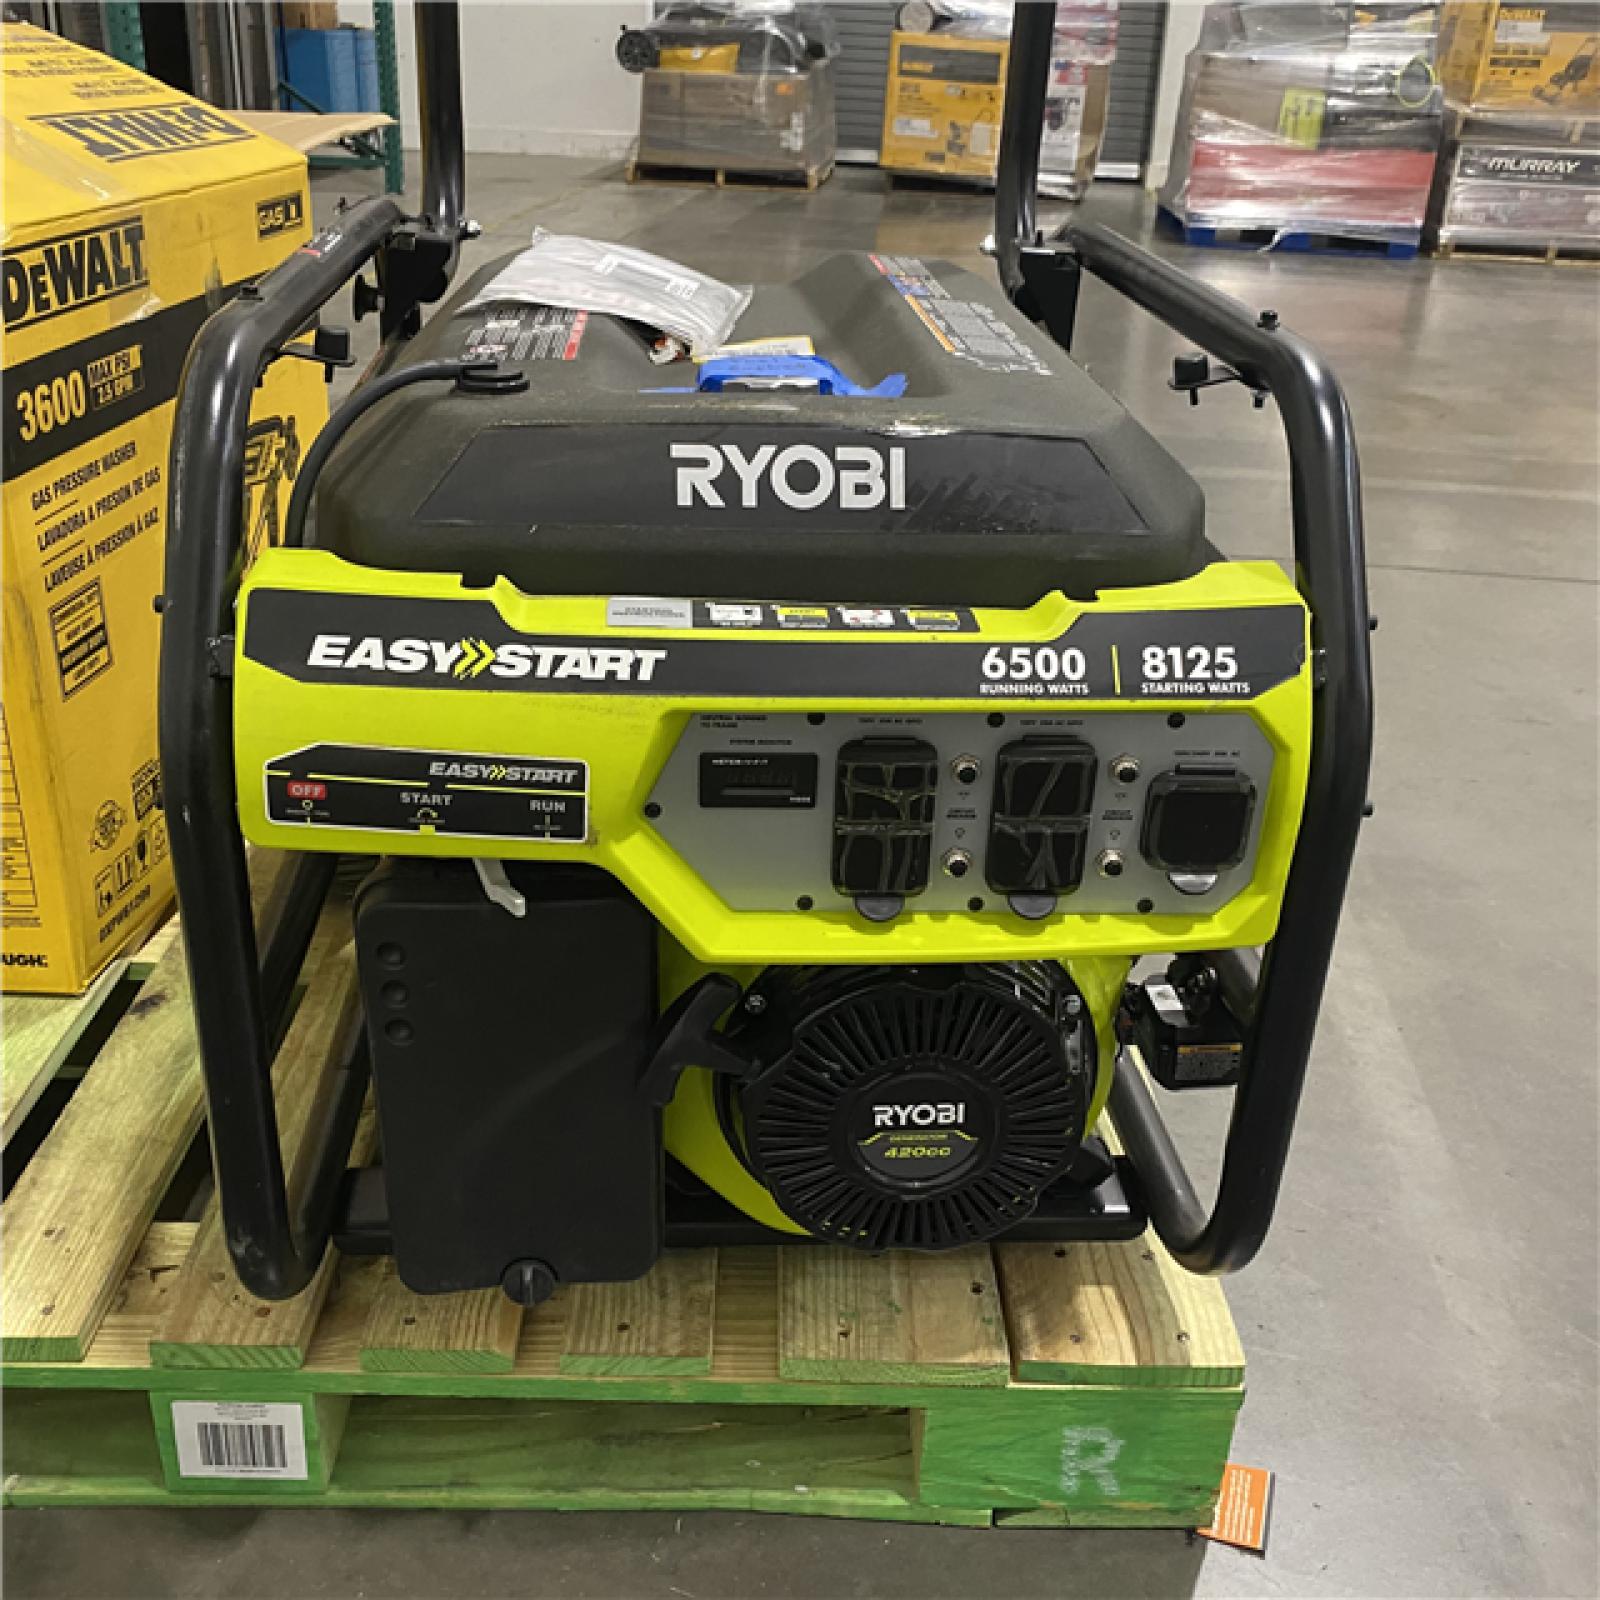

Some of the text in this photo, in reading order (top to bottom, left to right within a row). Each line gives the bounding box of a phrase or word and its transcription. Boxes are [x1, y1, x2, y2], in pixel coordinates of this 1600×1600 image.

[1487, 157, 1580, 173] MURRAY
[260, 204, 284, 232] GAS
[16, 370, 87, 441] 3600
[32, 441, 136, 511] GAS PRESSURE WASHER
[670, 443, 906, 510] RYOBI
[37, 509, 86, 551] LAVADORA
[133, 476, 144, 496] DE
[145, 465, 160, 489] GAS
[307, 634, 668, 681] EASY START
[982, 646, 1086, 681] 6500
[1141, 645, 1239, 680] 8125
[979, 682, 1090, 696] RUNNING WATTS
[1141, 681, 1250, 695] STARTING WATTS
[429, 761, 578, 784] EASY START
[291, 784, 323, 798] OFF
[401, 791, 453, 807] START
[529, 799, 566, 813] RUN
[872, 1102, 966, 1127] RYOBI
[1060, 1425, 1126, 1496] R
